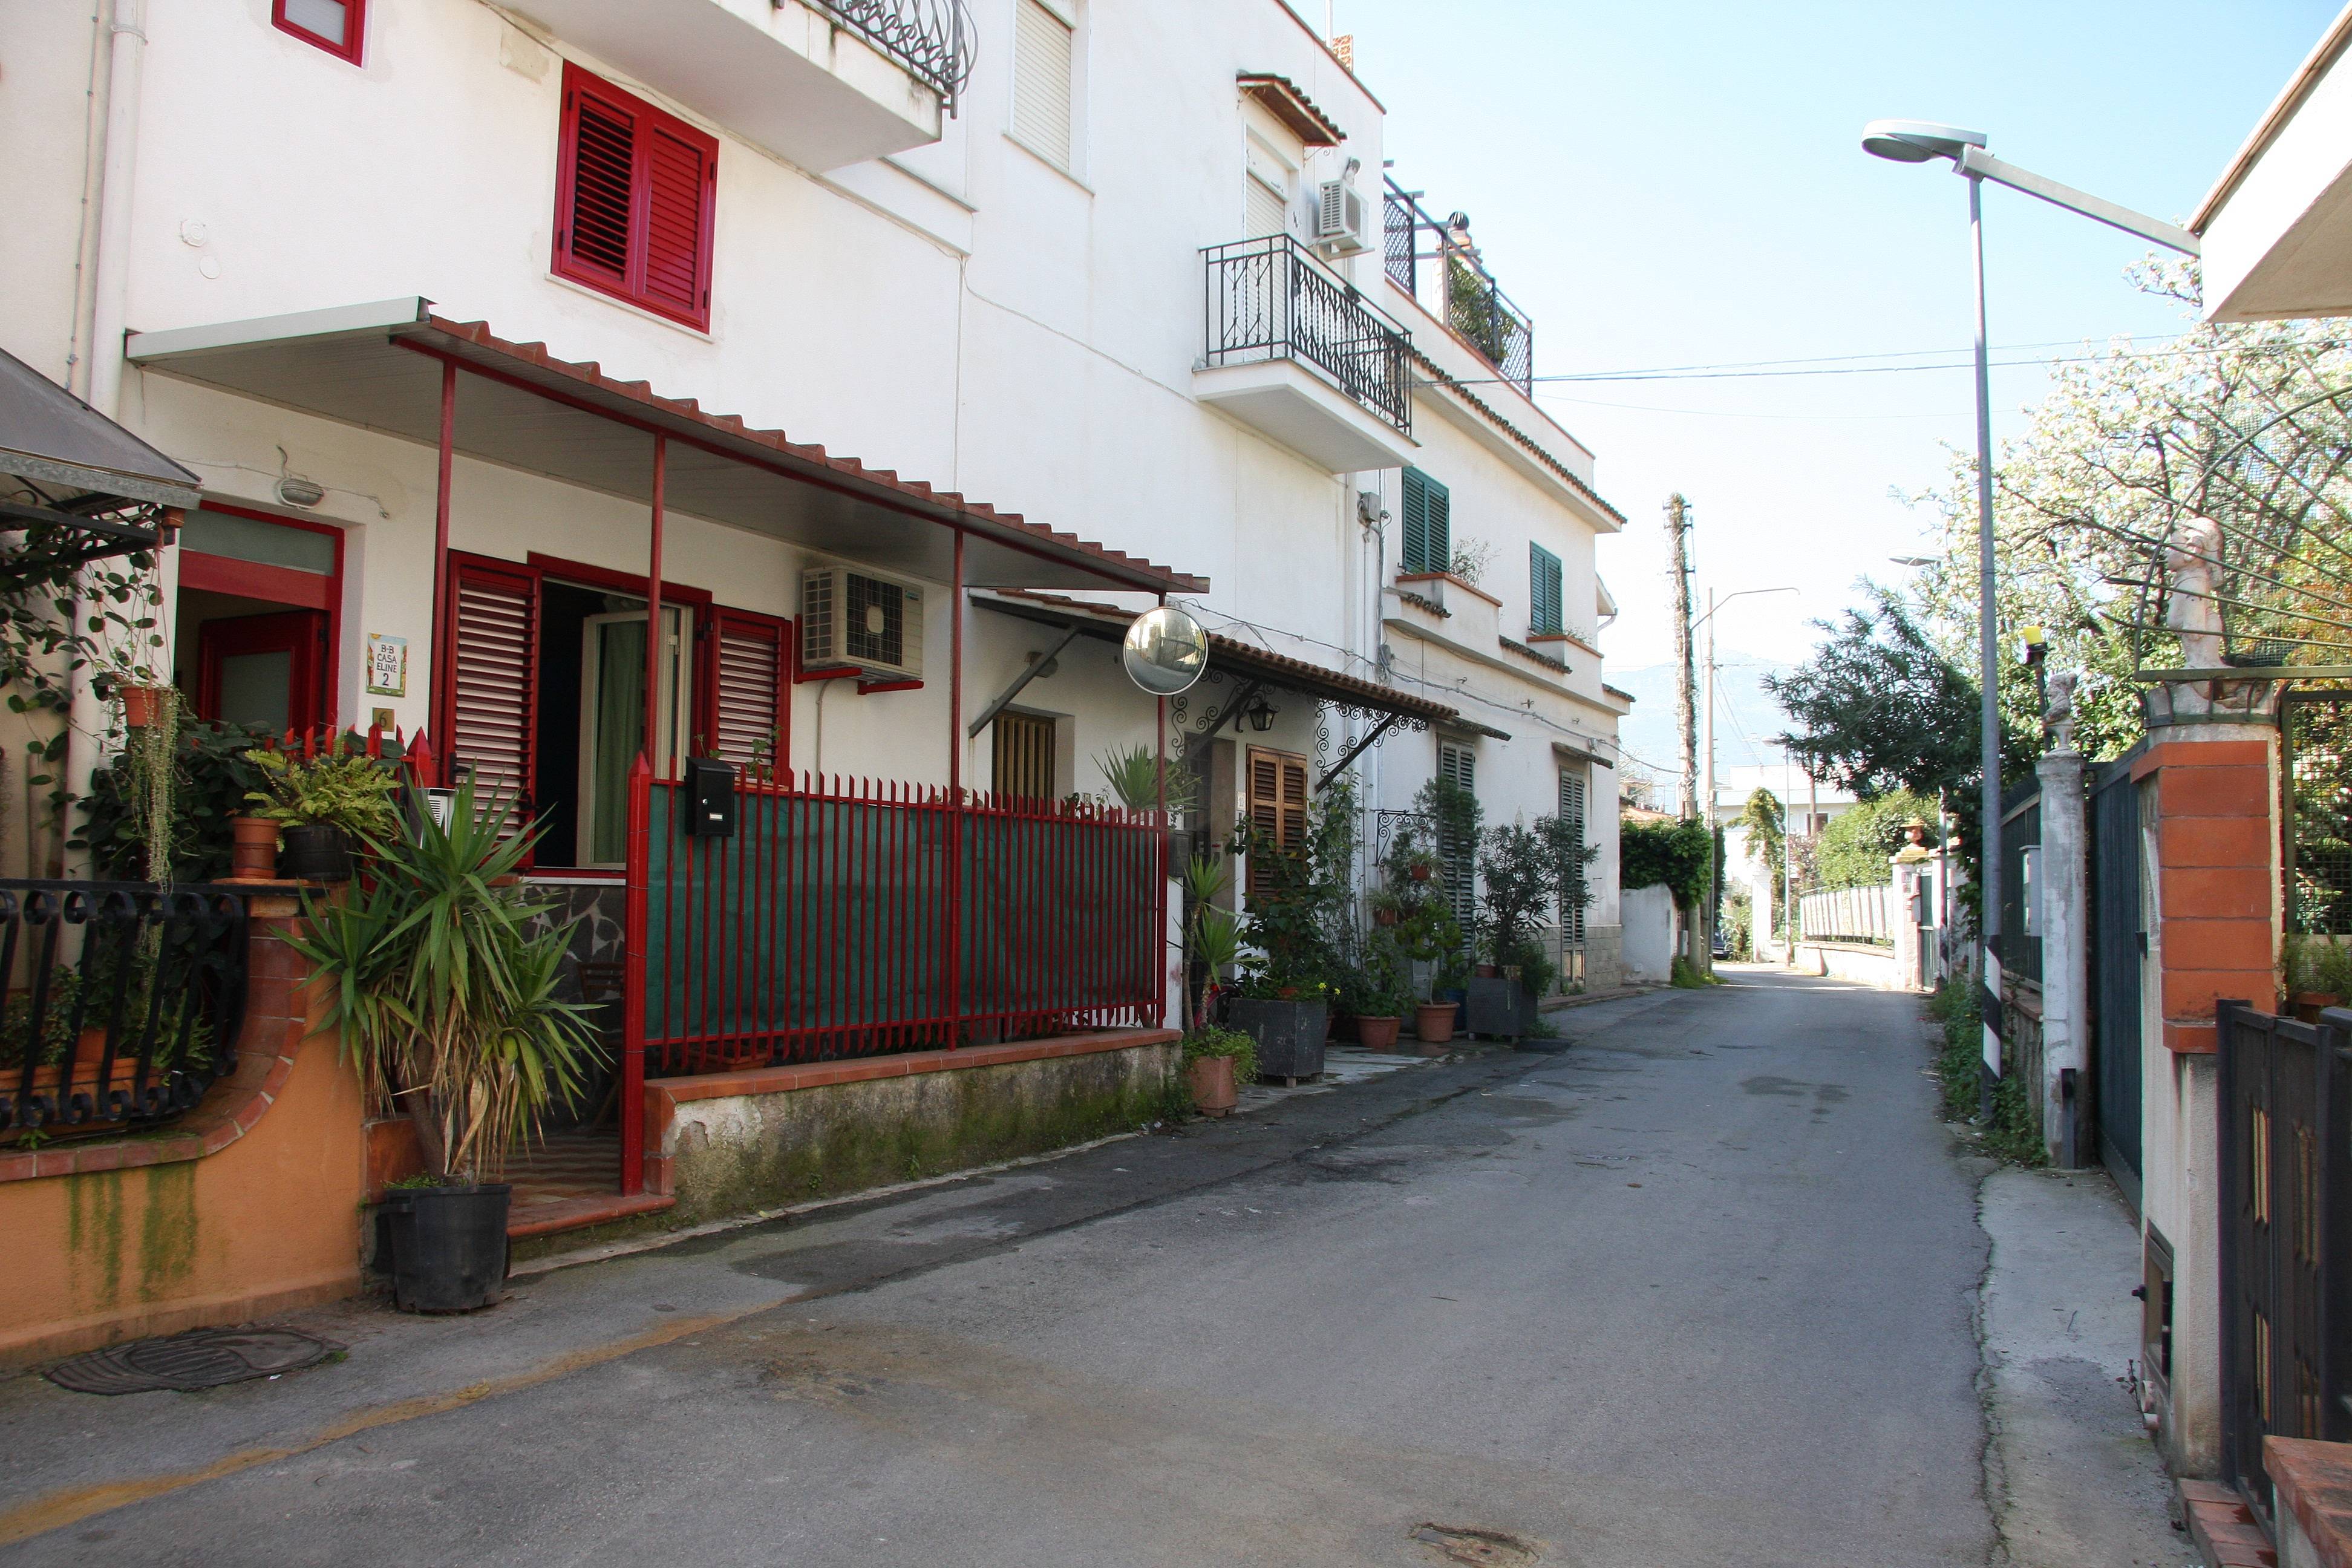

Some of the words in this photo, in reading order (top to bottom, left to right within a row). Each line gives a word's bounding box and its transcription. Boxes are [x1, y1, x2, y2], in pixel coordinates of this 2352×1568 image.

[381, 644, 394, 654] B-B
[377, 653, 397, 664] CASA
[376, 662, 397, 673] ELINE
[382, 673, 390, 686] 2
[379, 711, 387, 728] 6
